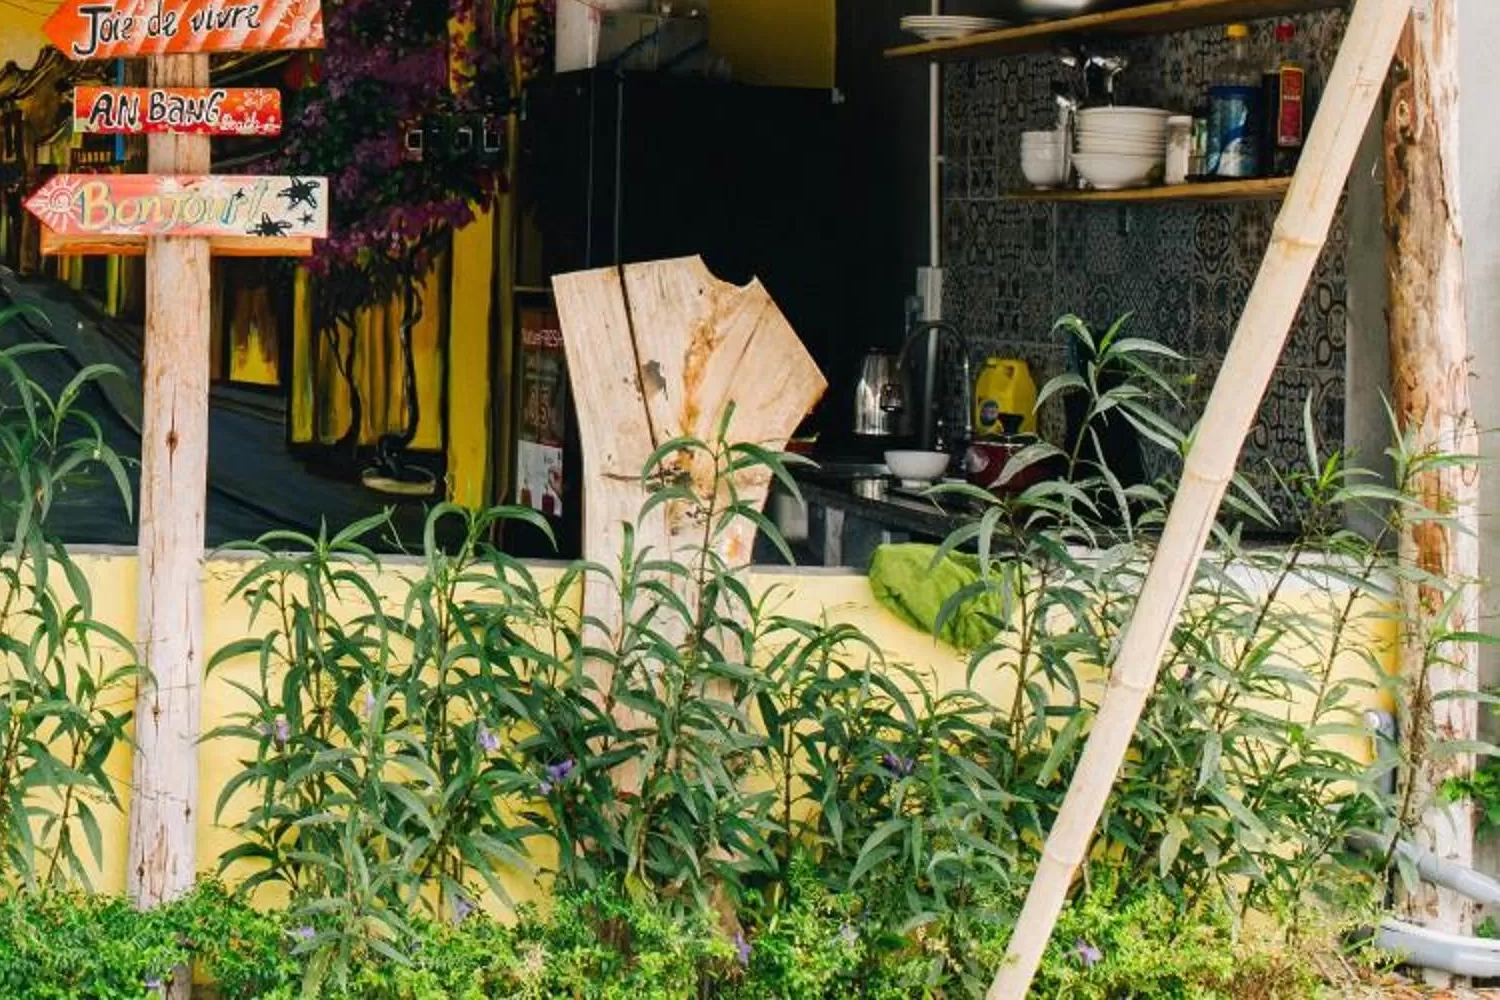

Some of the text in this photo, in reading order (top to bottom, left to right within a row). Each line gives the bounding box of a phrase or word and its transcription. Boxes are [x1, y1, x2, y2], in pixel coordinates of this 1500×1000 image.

[71, 3, 134, 59] Joie
[190, 2, 262, 33] vivre
[88, 91, 142, 129] AN
